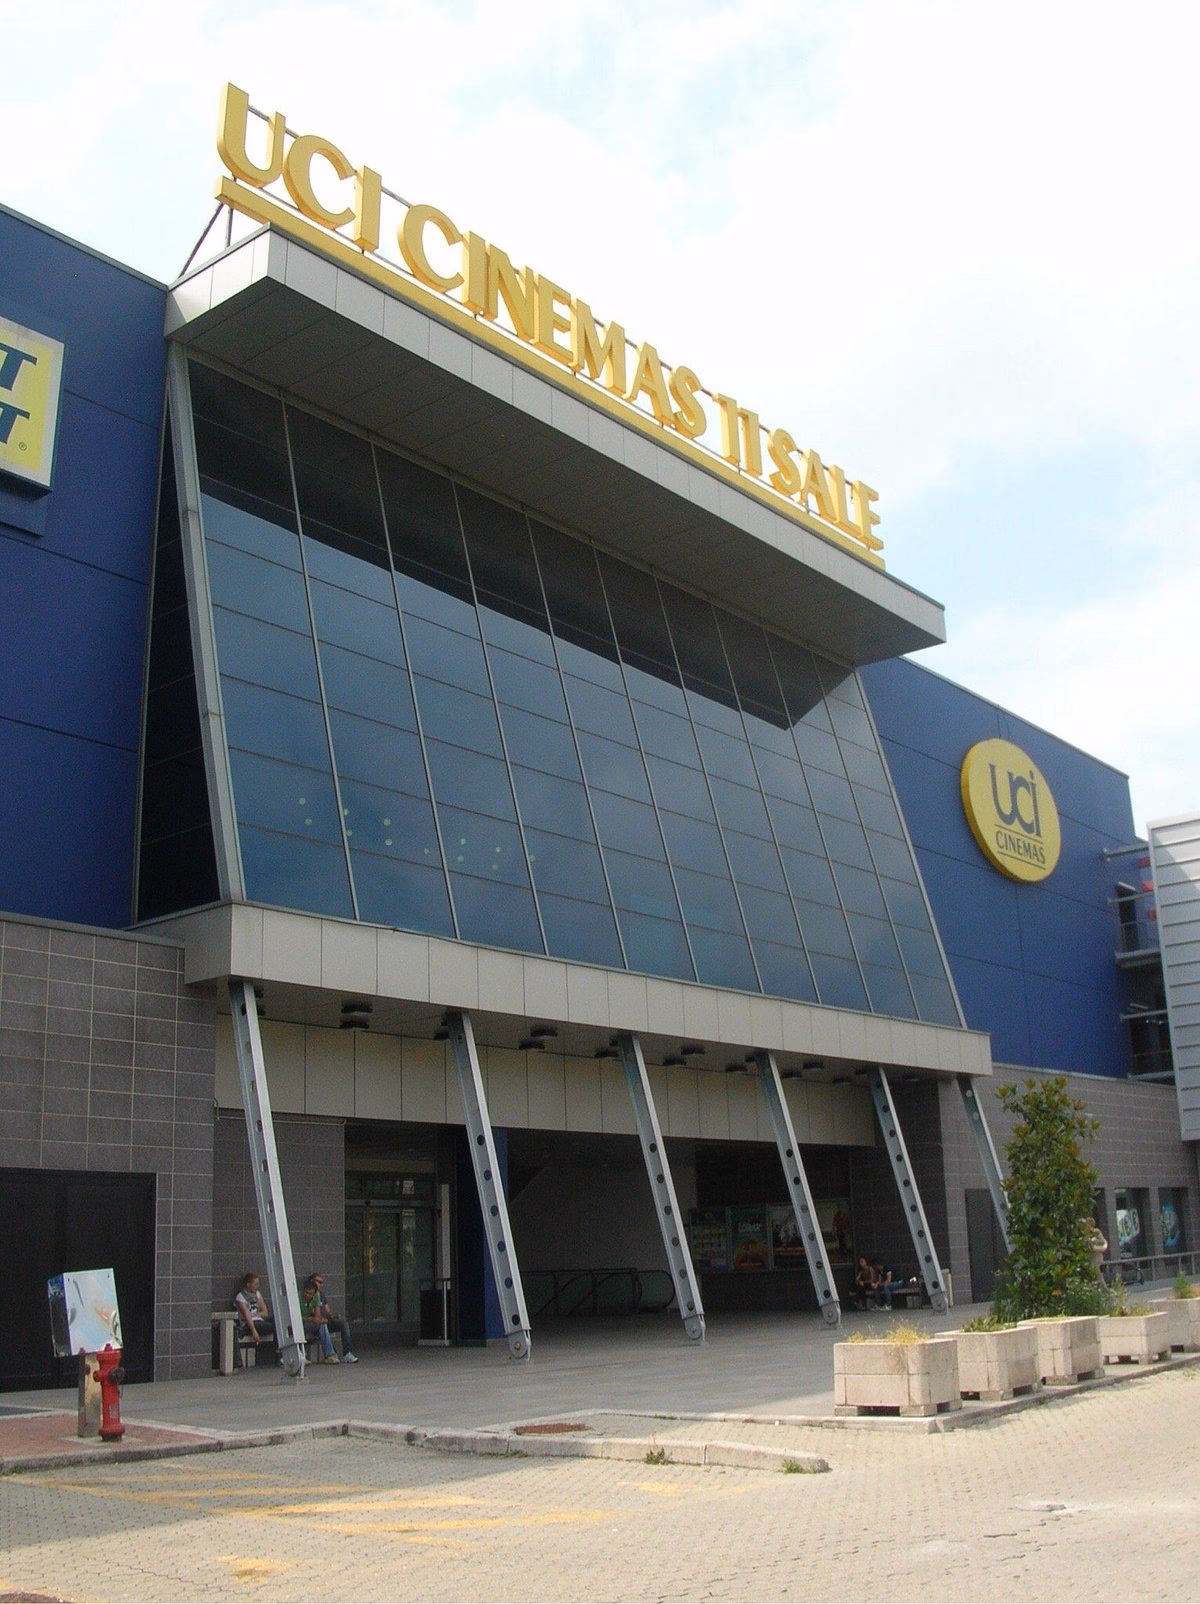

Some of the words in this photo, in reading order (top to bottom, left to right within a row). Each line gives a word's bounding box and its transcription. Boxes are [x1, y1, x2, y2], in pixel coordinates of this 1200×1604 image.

[216, 82, 381, 252] UCI
[397, 204, 707, 440] CINEMAS
[712, 393, 762, 478] 11
[767, 428, 884, 551] SALE
[996, 830, 1046, 865] CINEMAS
